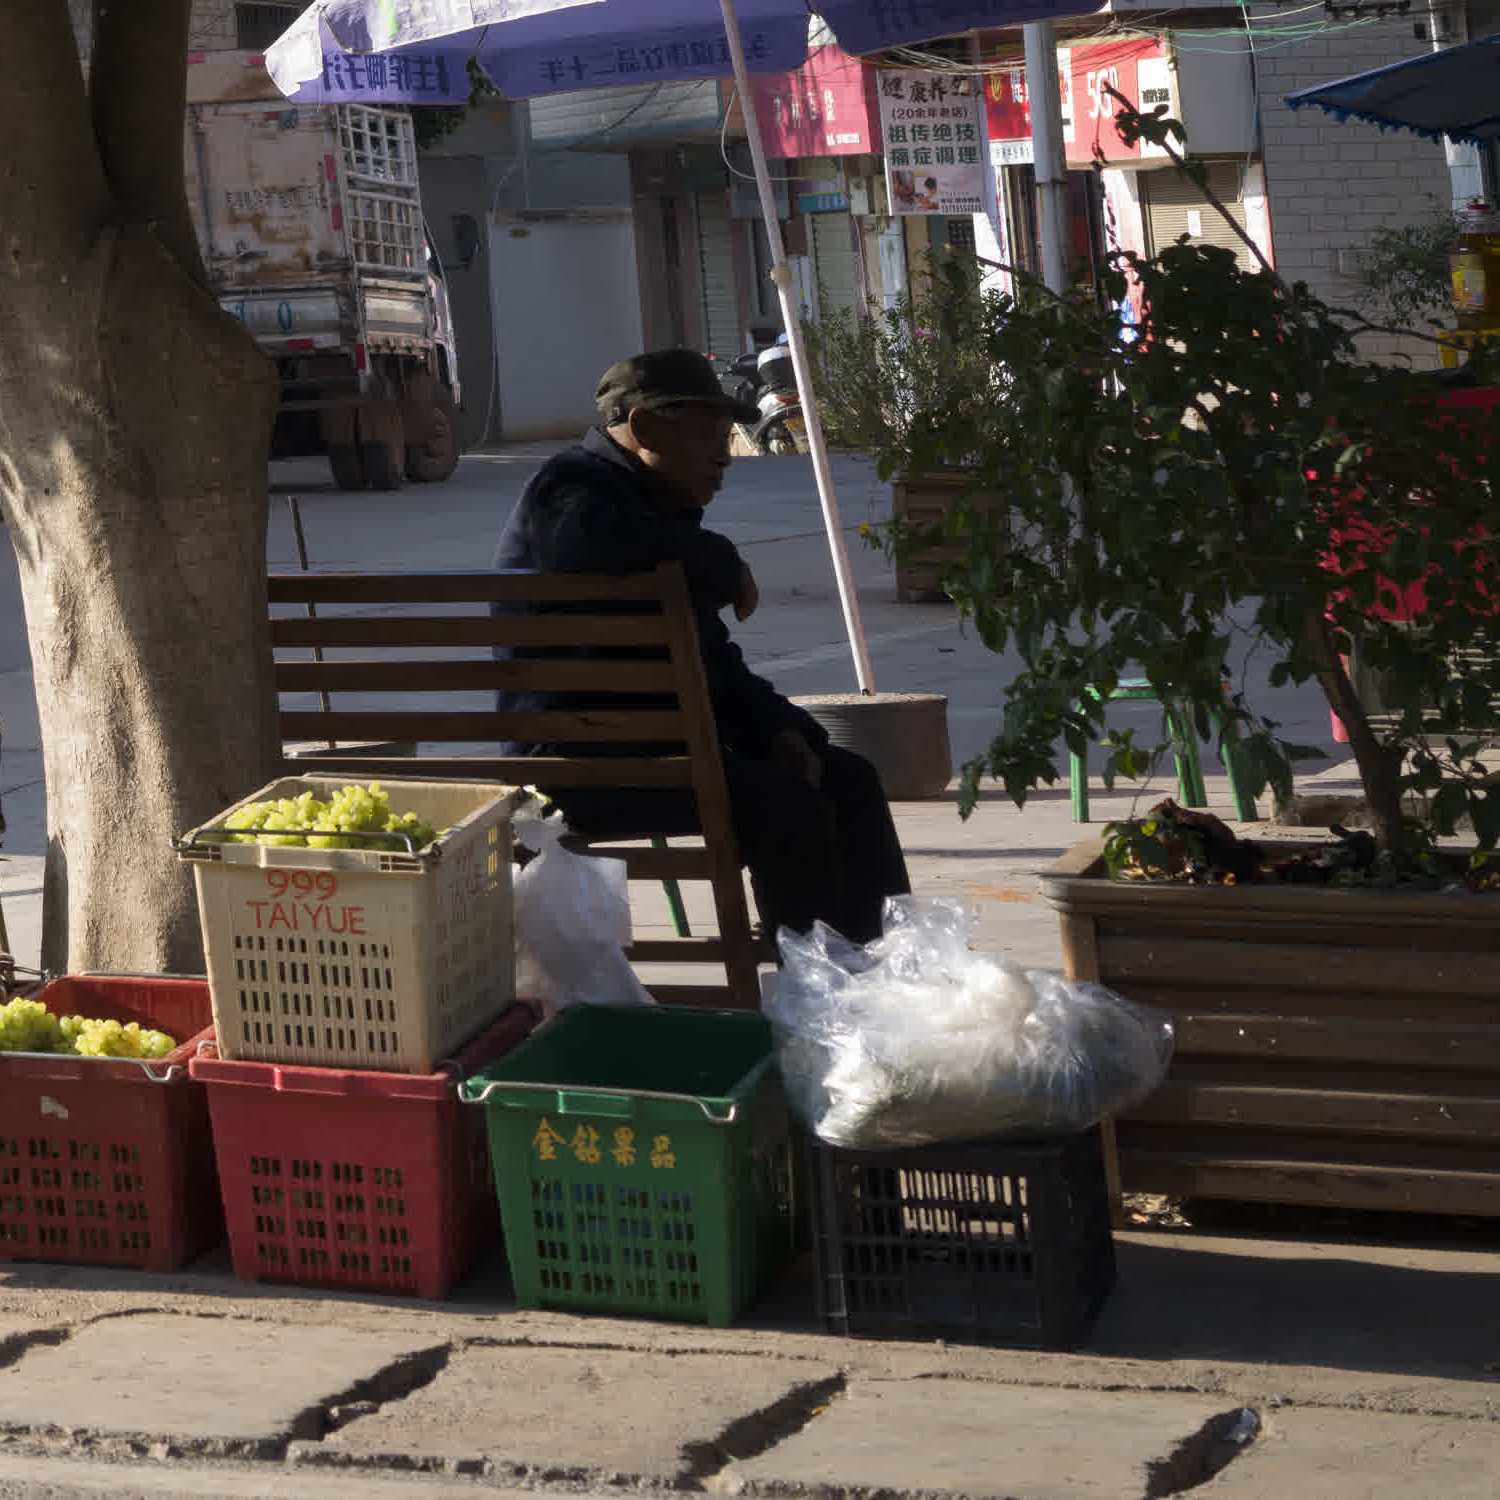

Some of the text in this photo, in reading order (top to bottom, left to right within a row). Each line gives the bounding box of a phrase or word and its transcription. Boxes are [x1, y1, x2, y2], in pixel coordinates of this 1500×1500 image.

[888, 123, 974, 143] 祖传绝技
[265, 869, 338, 900] 999
[532, 1117, 676, 1169] 金钻果品
